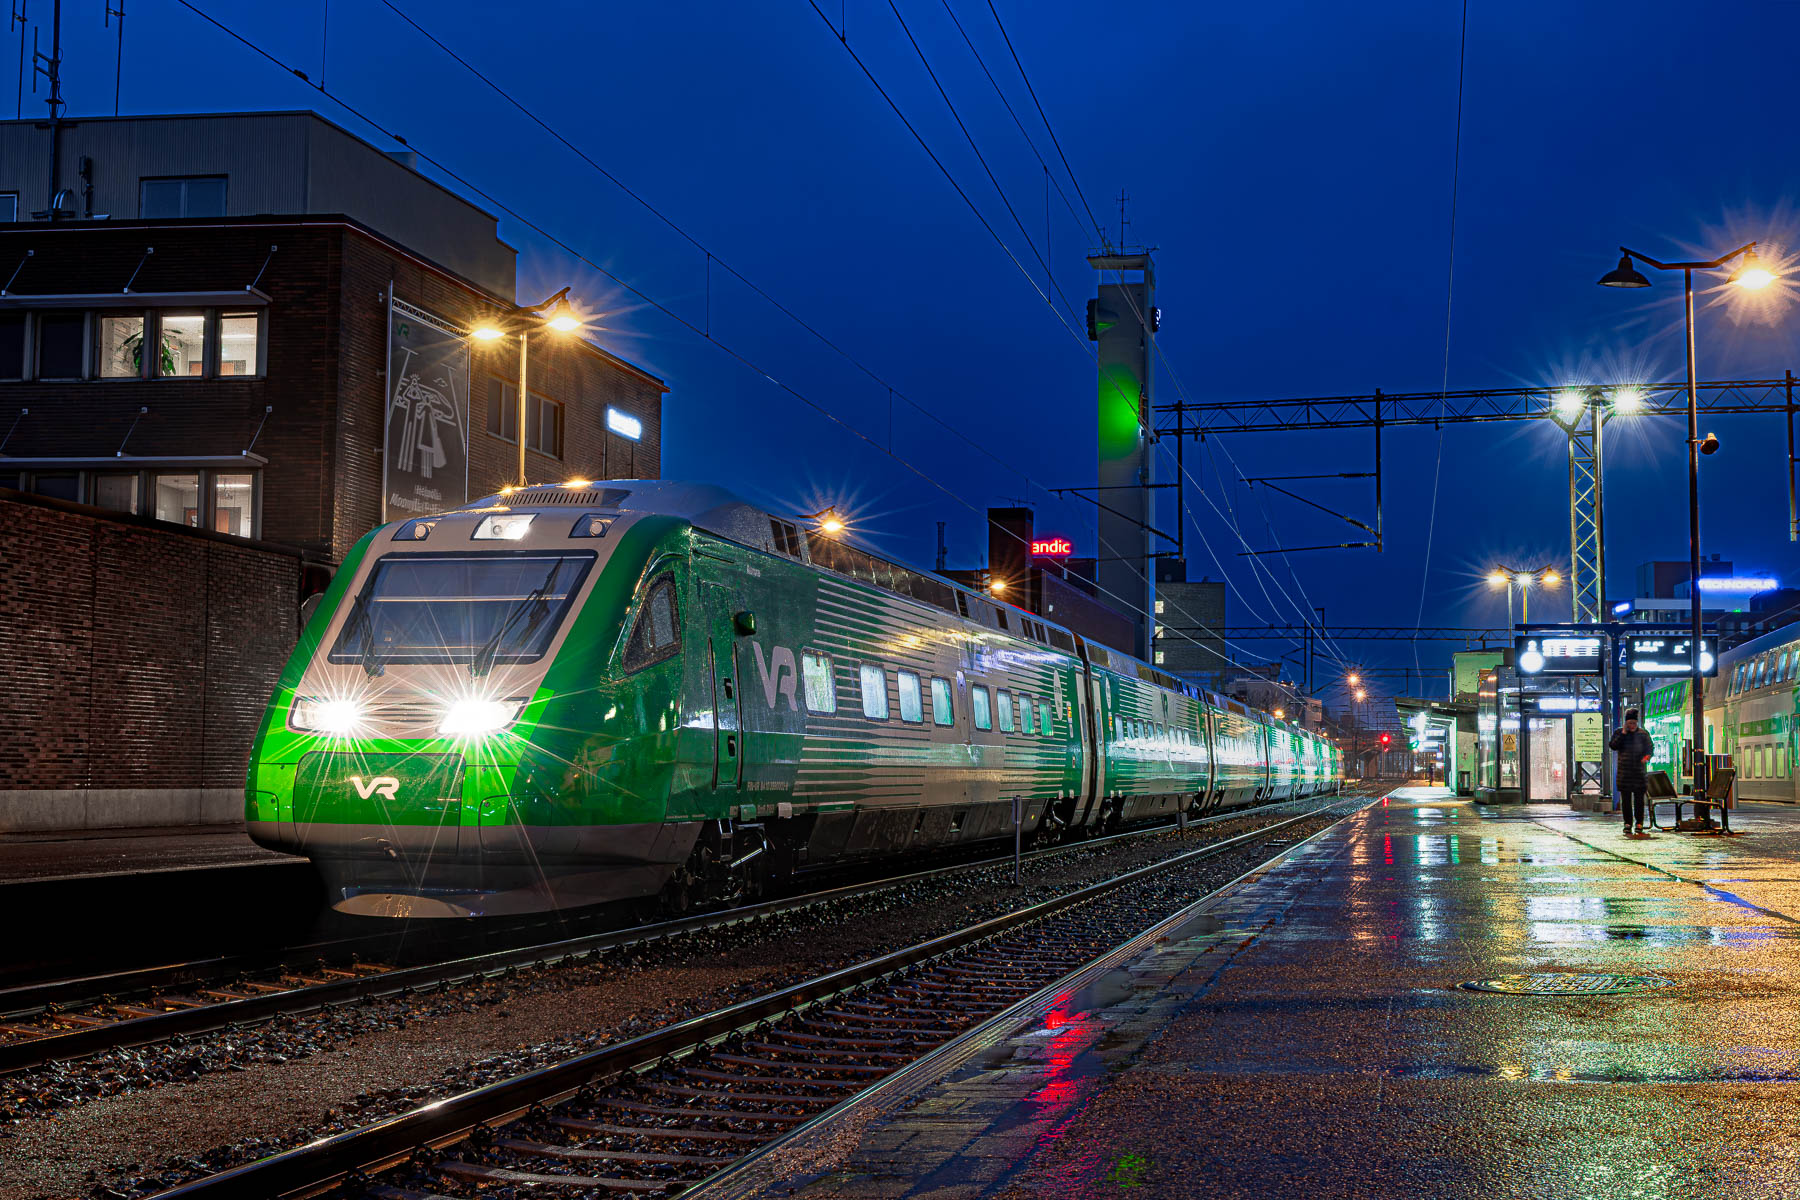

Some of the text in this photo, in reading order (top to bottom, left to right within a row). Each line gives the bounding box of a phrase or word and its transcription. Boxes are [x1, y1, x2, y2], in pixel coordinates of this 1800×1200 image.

[396, 322, 410, 339] VR
[1032, 539, 1070, 553] andic
[752, 641, 799, 712] VR
[350, 775, 400, 800] VR
